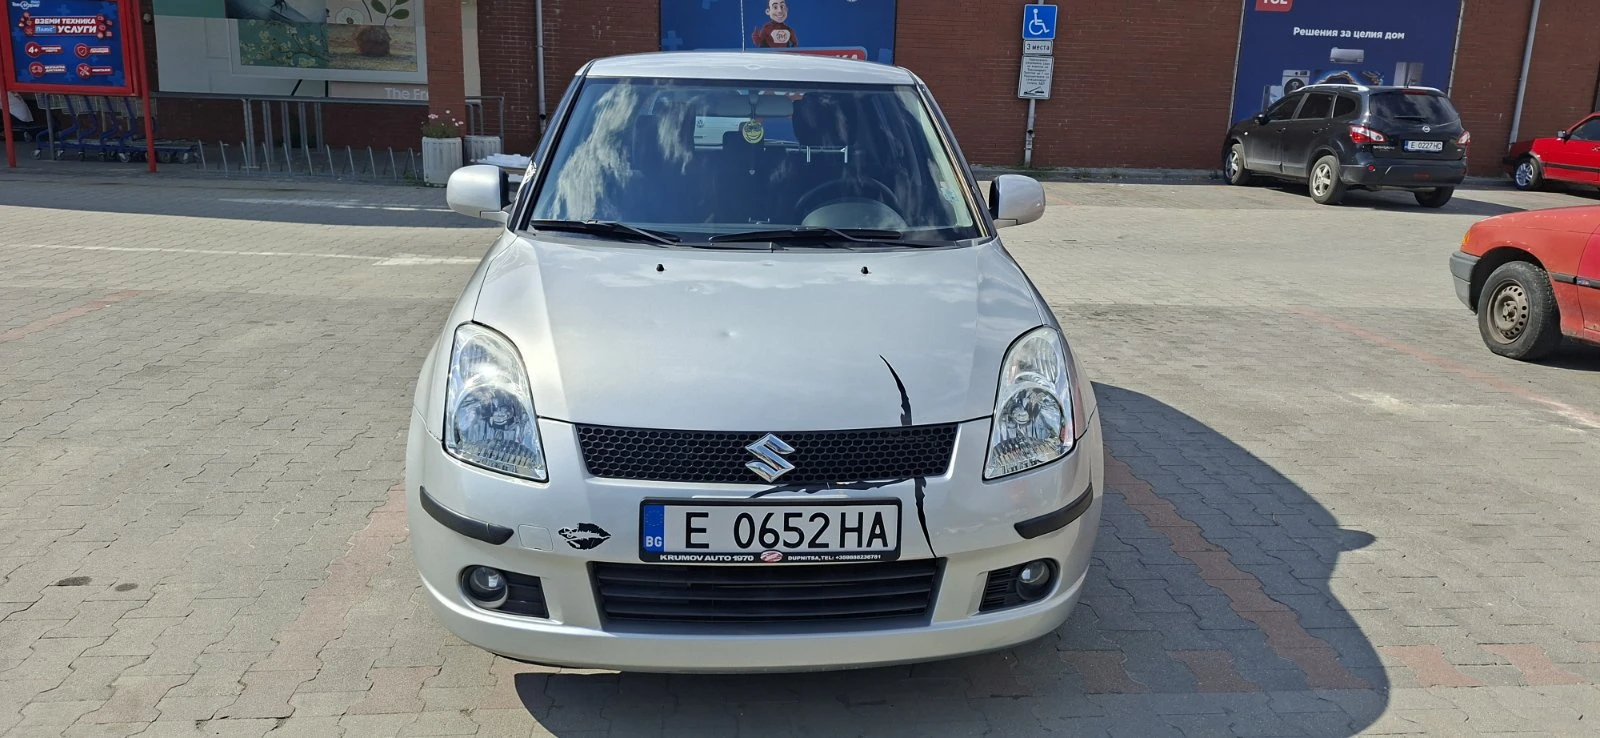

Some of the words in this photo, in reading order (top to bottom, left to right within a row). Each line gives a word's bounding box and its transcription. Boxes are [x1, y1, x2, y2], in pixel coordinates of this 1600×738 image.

[57, 25, 97, 34] УСЛУГИ
[1293, 26, 1338, 37] Решения
[1339, 29, 1351, 38] за
[1353, 30, 1383, 40] целия
[1384, 31, 1405, 40] дом
[28, 45, 39, 54] 4+
[1026, 43, 1031, 51] 3
[384, 87, 410, 100] The
[413, 88, 429, 101] Fr
[1410, 141, 1416, 149] E
[685, 511, 710, 549] E
[733, 511, 831, 549] 0652
[839, 511, 889, 549] HA
[645, 535, 663, 548] BG
[659, 554, 703, 562] KRUMOV
[704, 554, 732, 562] AUTO
[732, 554, 755, 562] 1970
